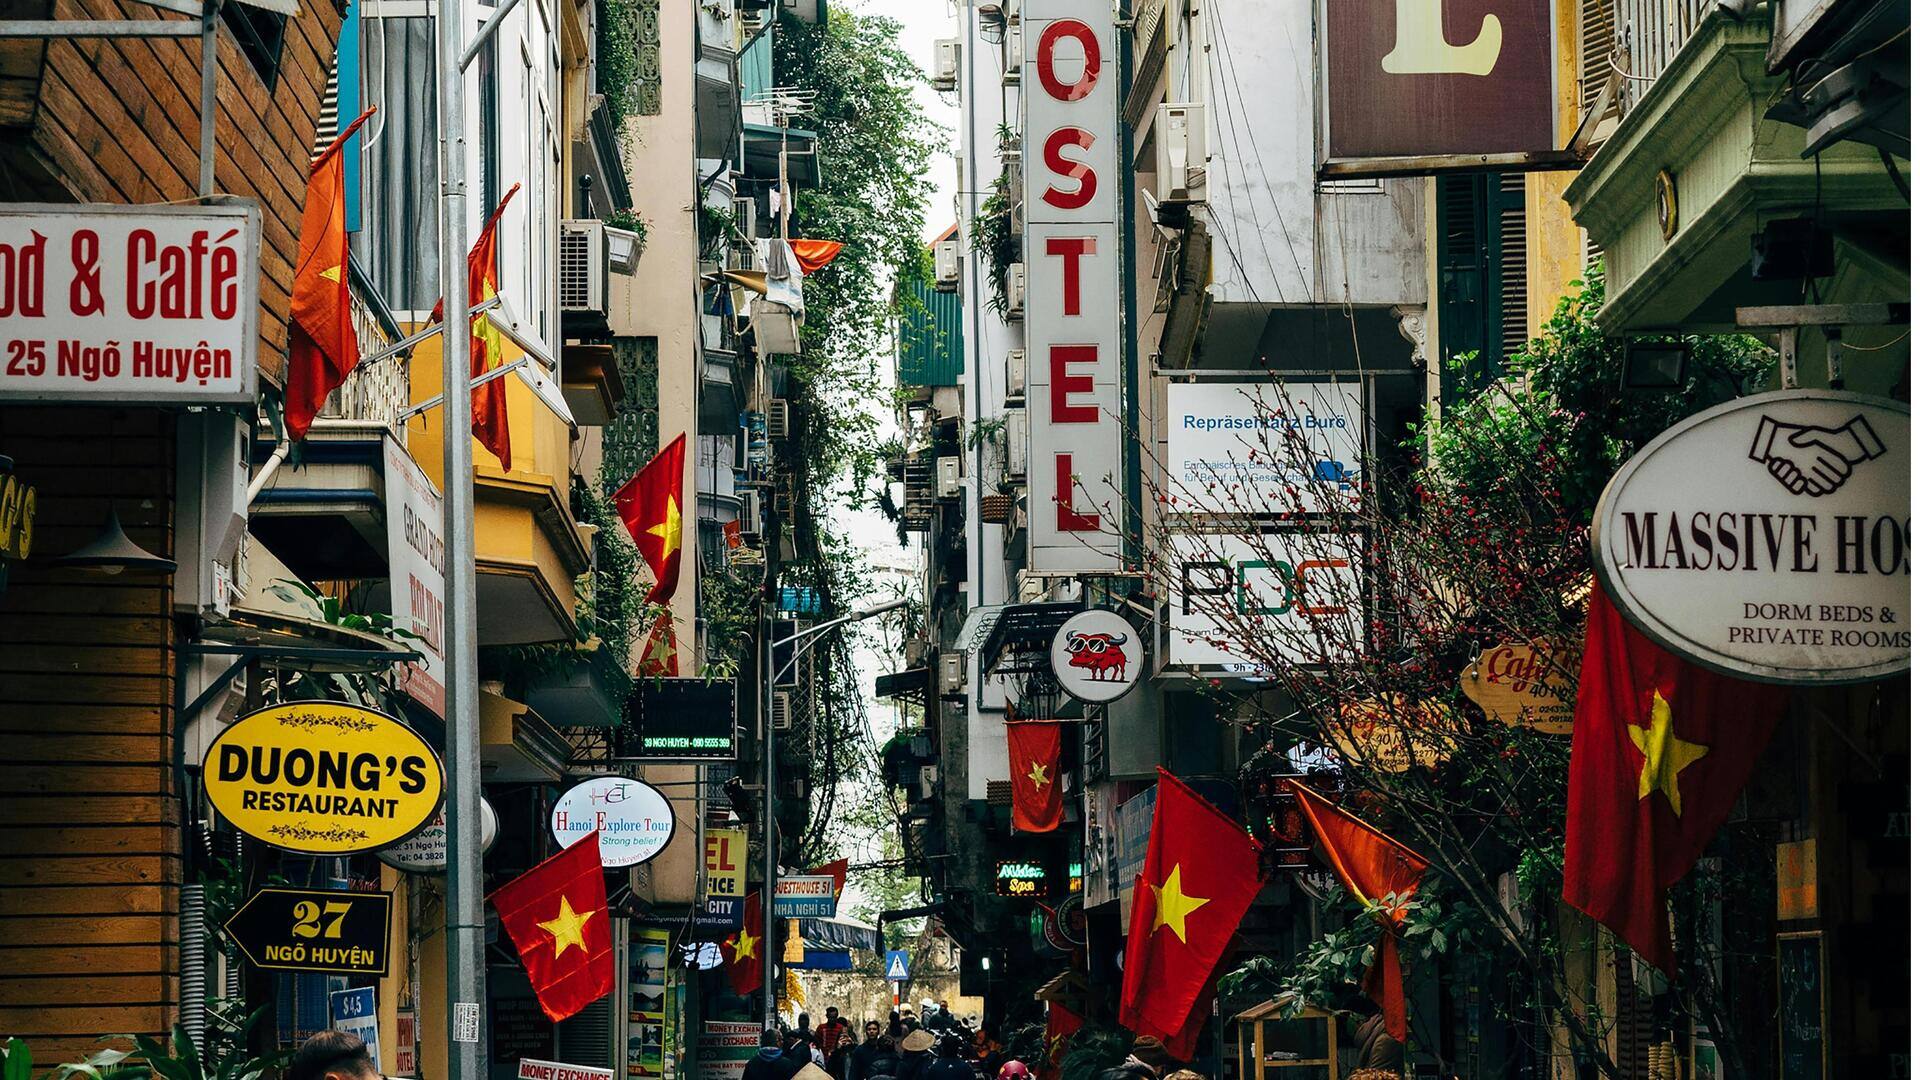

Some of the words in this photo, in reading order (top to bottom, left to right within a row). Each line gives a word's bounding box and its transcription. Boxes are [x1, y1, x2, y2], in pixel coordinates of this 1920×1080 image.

[70, 229, 105, 317] &
[127, 229, 239, 320] Café
[1037, 18, 1101, 532] OSTEL
[6, 340, 46, 376] 25
[57, 340, 121, 381] Ngõ
[132, 340, 232, 385] Huyện
[1621, 511, 1819, 572] MASSIVE
[1182, 560, 1349, 616] PDC
[1743, 602, 1812, 621] DORM
[1819, 605, 1873, 623] BEDS
[1879, 606, 1897, 623] &
[1728, 627, 1824, 646] PRIVATE
[1830, 630, 1912, 648] ROOMS
[1529, 684, 1548, 698] 40
[219, 744, 427, 794] DUONG'S
[242, 790, 399, 819] RESTAURANT
[555, 811, 592, 832] Hanoi
[596, 811, 641, 835] Explore
[644, 818, 671, 832] Tour
[416, 842, 433, 851] Ngo
[602, 836, 631, 847] Strong
[397, 853, 411, 862] Tel:
[413, 853, 423, 861] 04
[1009, 878, 1035, 894] Spa
[708, 900, 733, 914] CITY
[821, 903, 831, 915] 51
[292, 900, 353, 939] 27
[265, 943, 306, 962] NGÕ
[311, 945, 375, 969] HUYỆN
[733, 1025, 761, 1034] EXCHAN
[723, 1036, 759, 1046] EXCHANGE
[520, 1064, 556, 1080] MONEY
[557, 1069, 610, 1080] EXCHANGE
